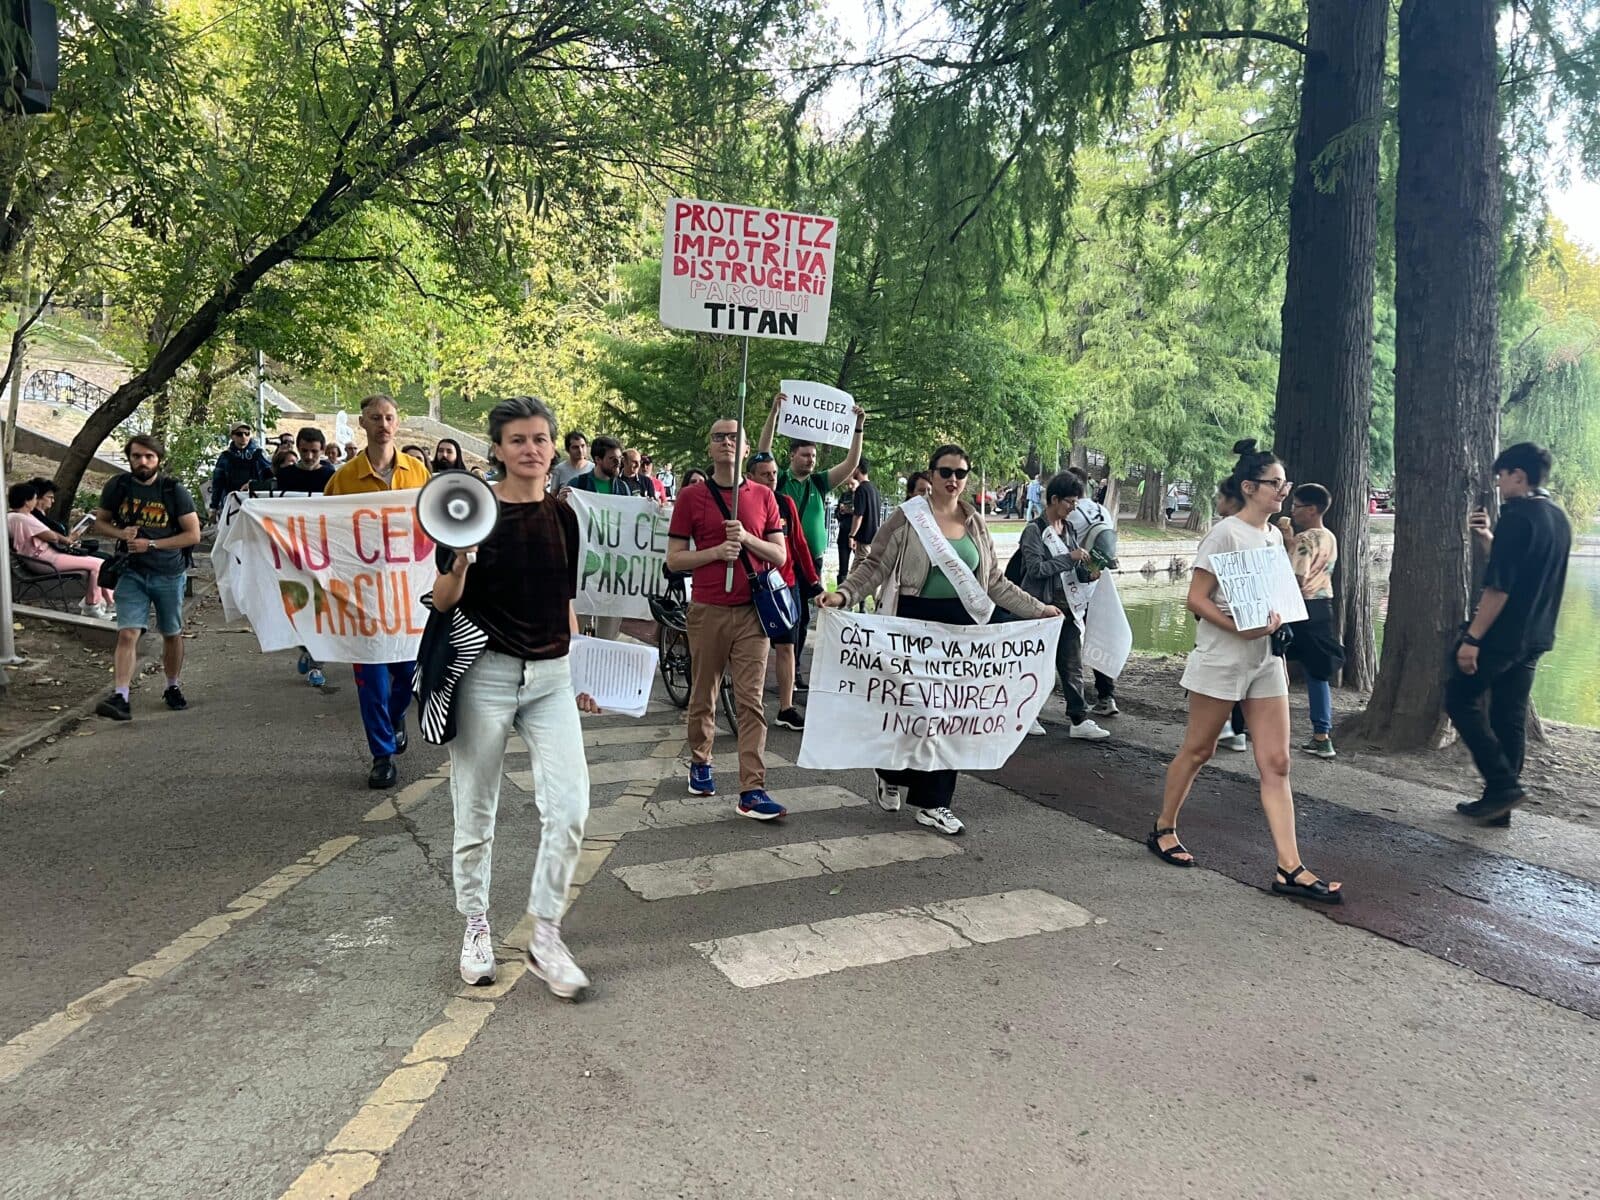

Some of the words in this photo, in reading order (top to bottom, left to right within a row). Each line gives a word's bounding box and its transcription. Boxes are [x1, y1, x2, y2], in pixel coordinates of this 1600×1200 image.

[674, 203, 834, 249] PROTESTEZ
[793, 394, 810, 407] NU
[813, 399, 847, 414] CEDEZ
[784, 414, 828, 430] PARCUL
[831, 422, 850, 434] IOR
[262, 514, 330, 571] NU
[353, 505, 437, 564] CED
[588, 507, 621, 548] NU
[635, 513, 669, 553] CE
[278, 571, 424, 637] PARCUL
[840, 623, 874, 648] CÂT
[887, 632, 933, 654] TIMP
[942, 641, 963, 658] VA
[970, 643, 995, 660] MAI
[1002, 639, 1045, 659] DURA
[838, 680, 856, 693] PT
[867, 677, 1008, 710] PREVENIREA
[882, 711, 1007, 738] INCENDIILOR
